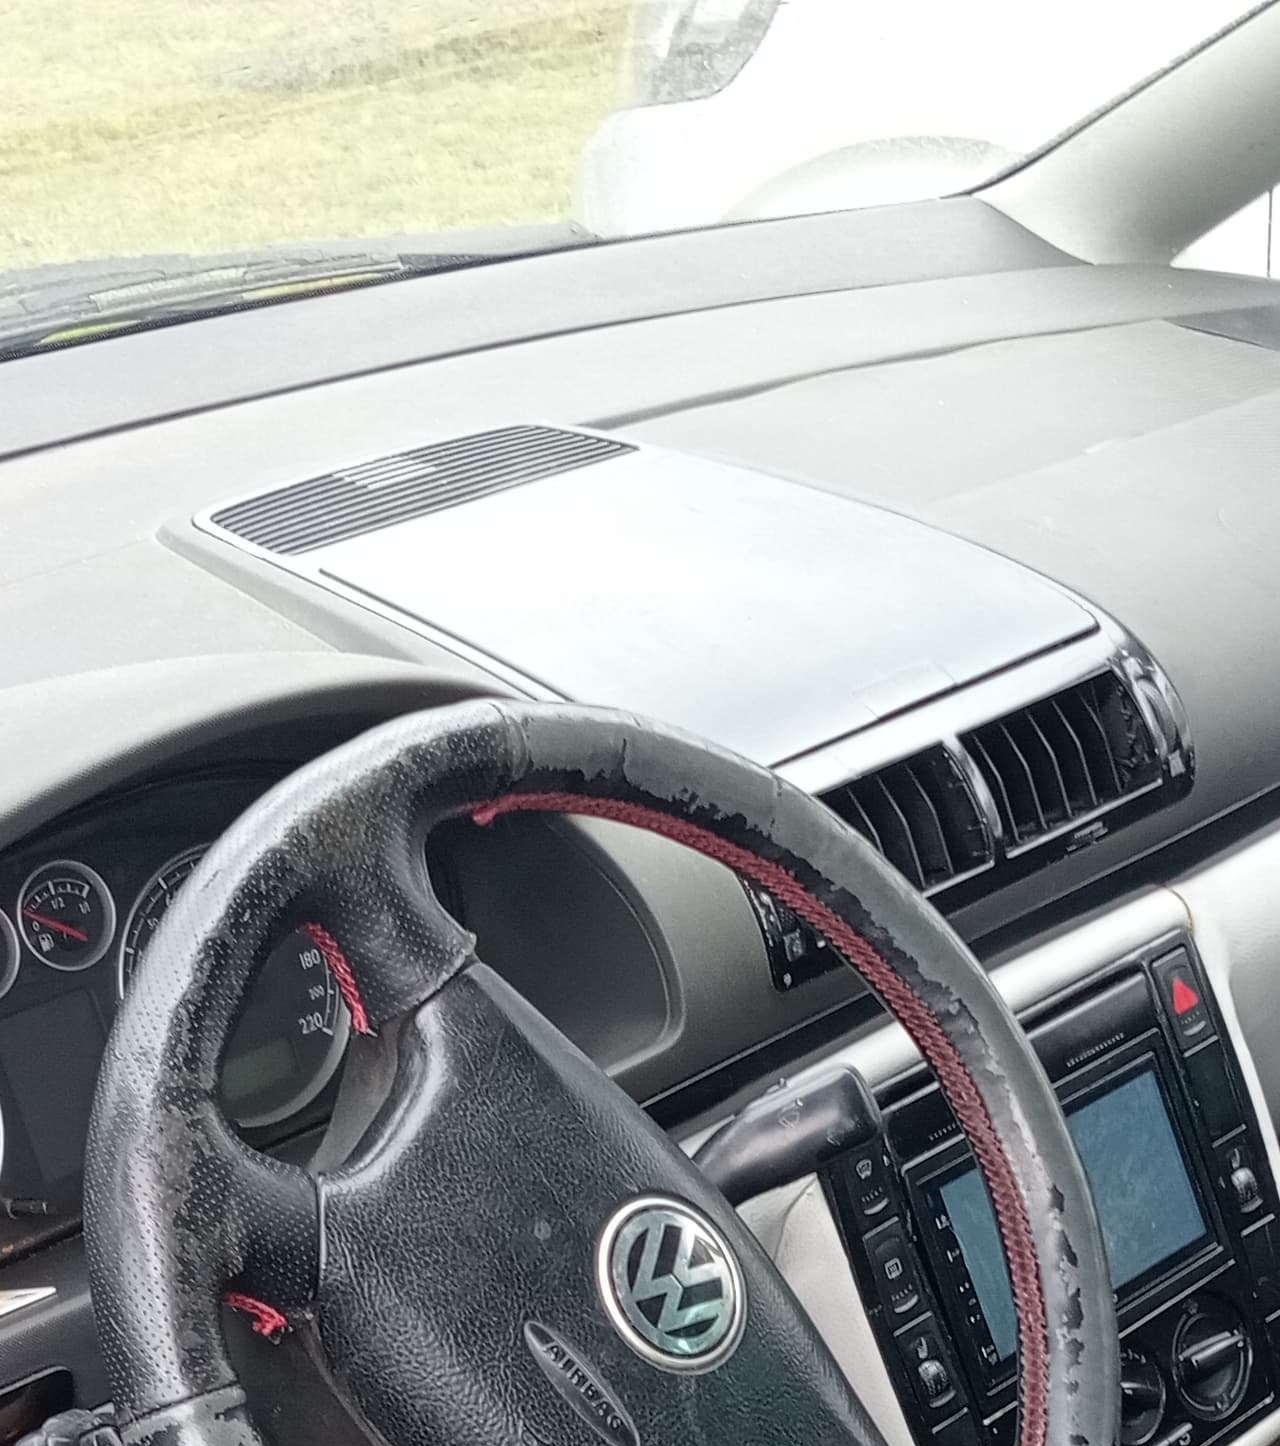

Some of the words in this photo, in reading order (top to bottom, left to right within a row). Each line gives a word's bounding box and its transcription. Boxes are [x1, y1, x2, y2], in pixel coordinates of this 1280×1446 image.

[299, 949, 320, 970] 180
[298, 1012, 323, 1034] 220
[543, 1342, 621, 1431] AIRBAG
